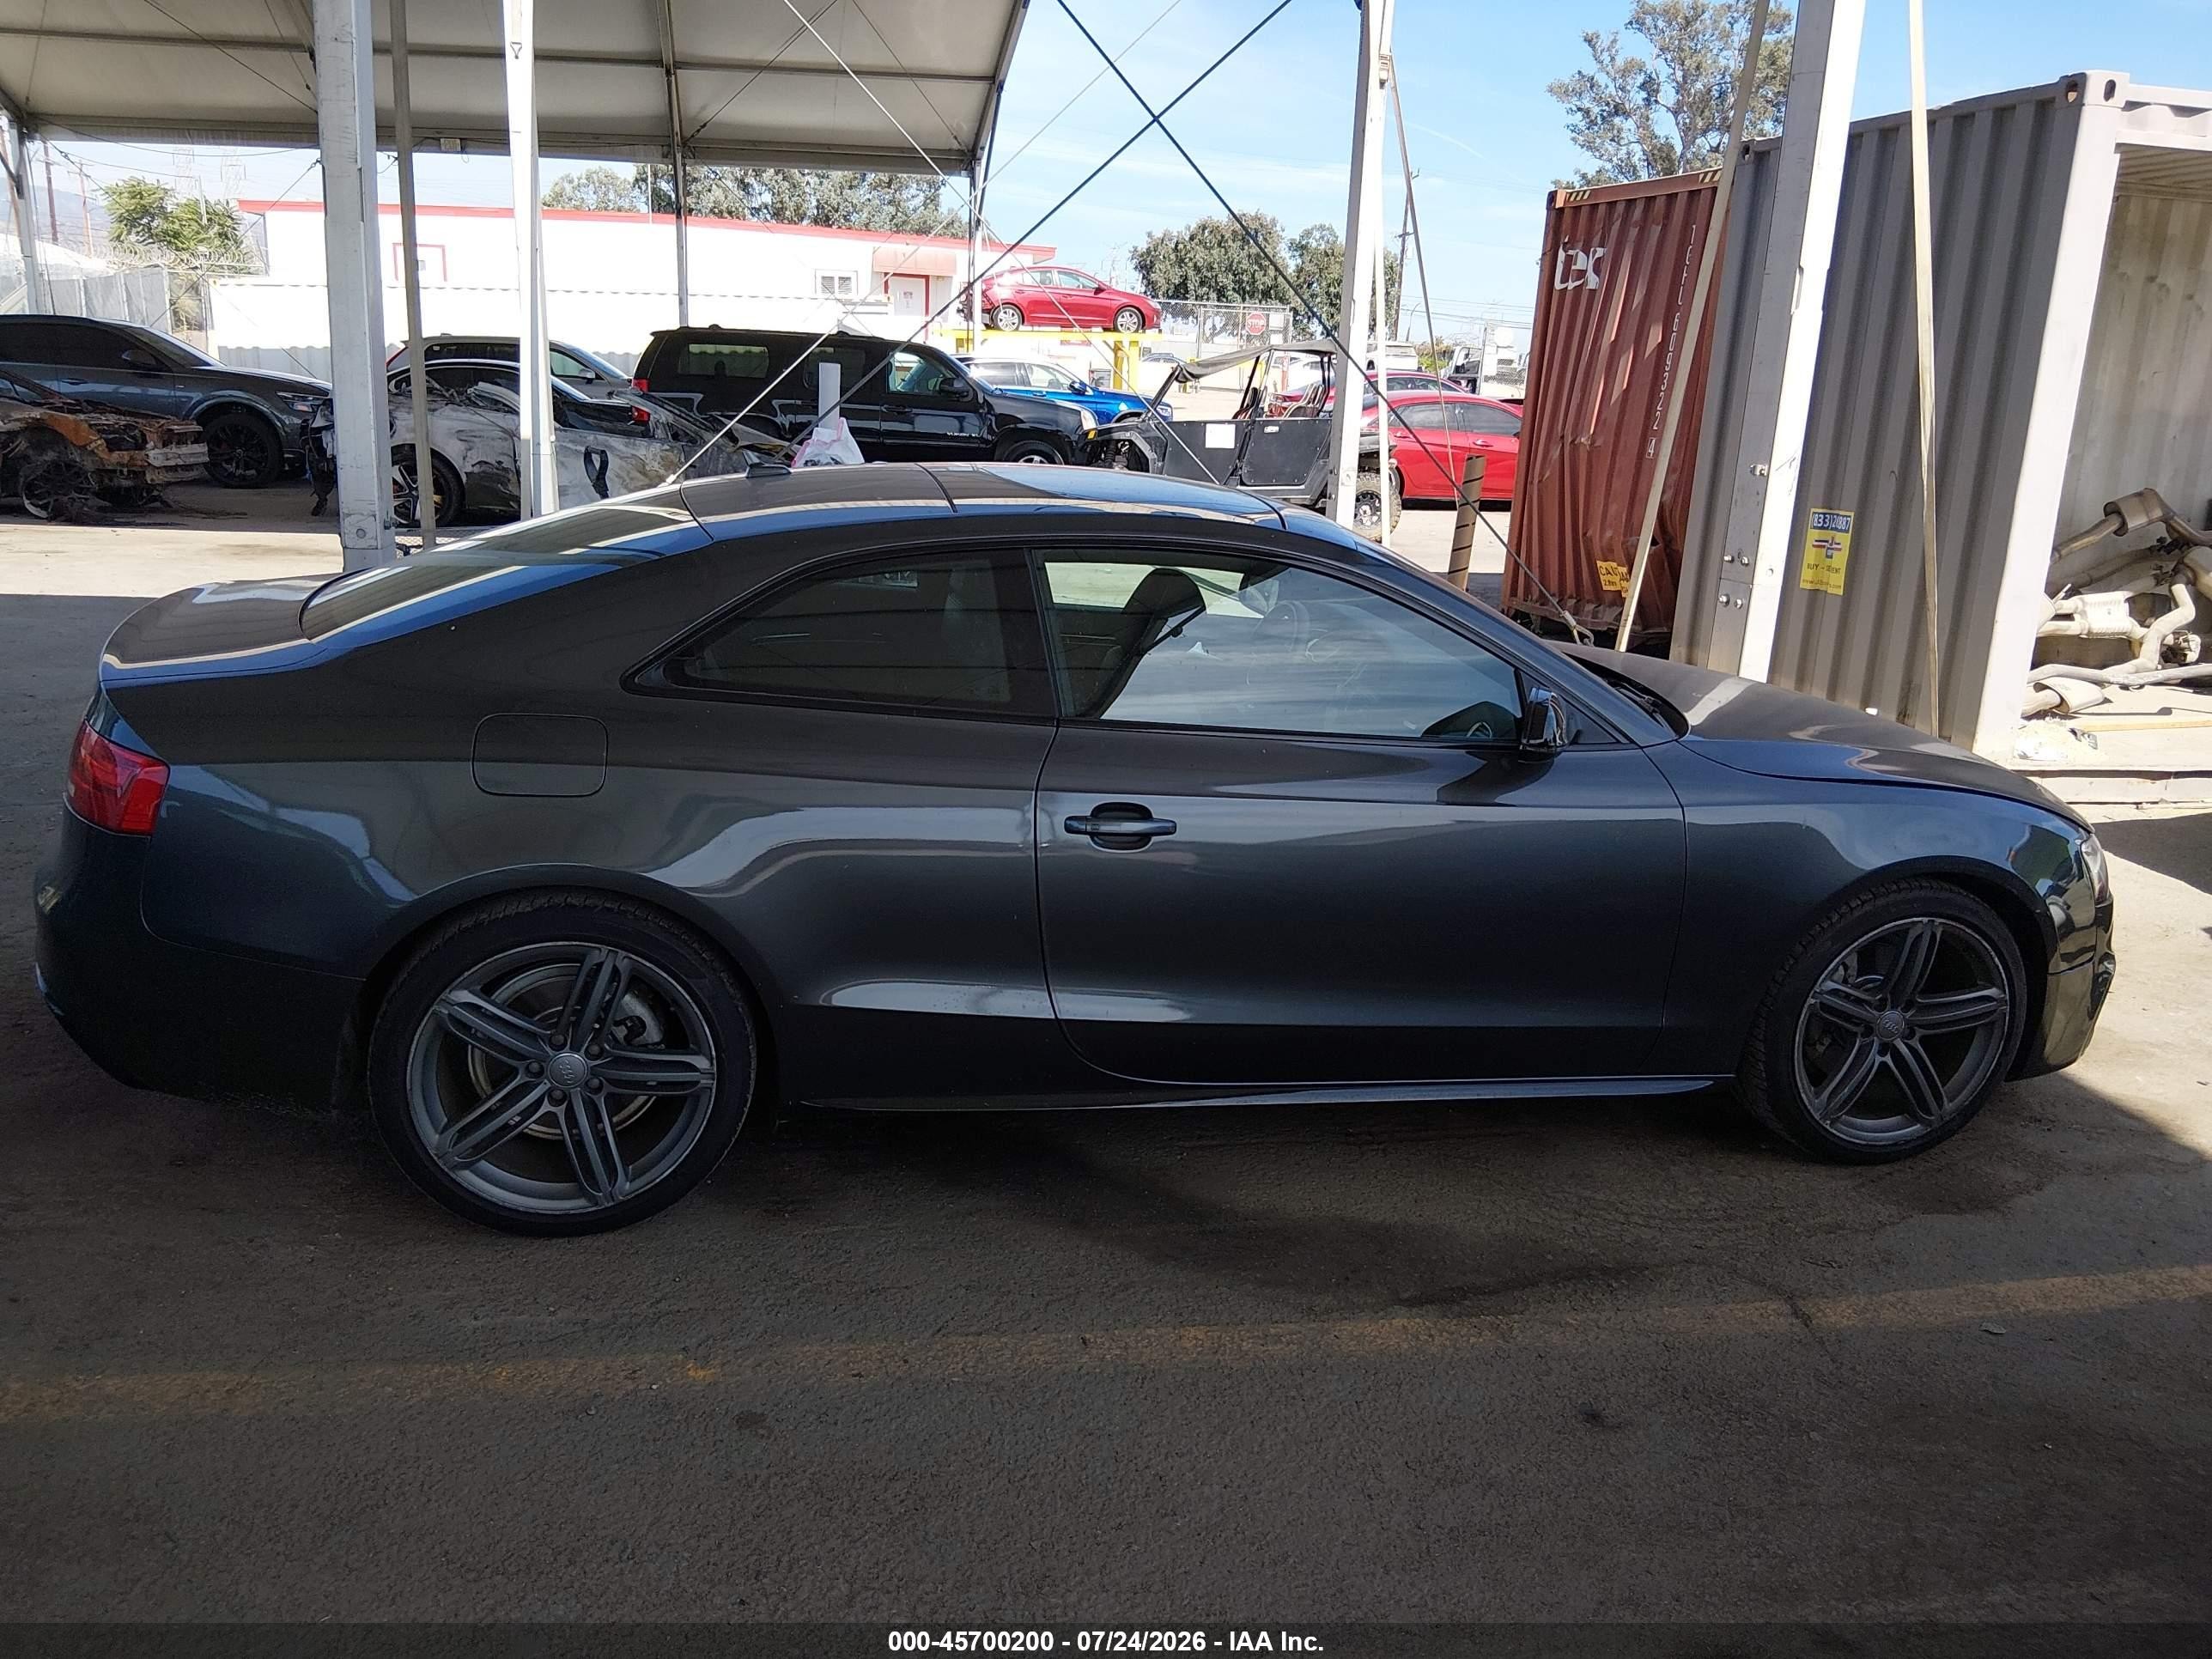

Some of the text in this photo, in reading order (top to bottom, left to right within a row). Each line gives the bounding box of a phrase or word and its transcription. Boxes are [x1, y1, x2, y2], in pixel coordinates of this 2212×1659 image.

[1247, 319, 1265, 328] STOP
[1652, 312, 1680, 430] 609322
[1648, 438, 1656, 458] 4
